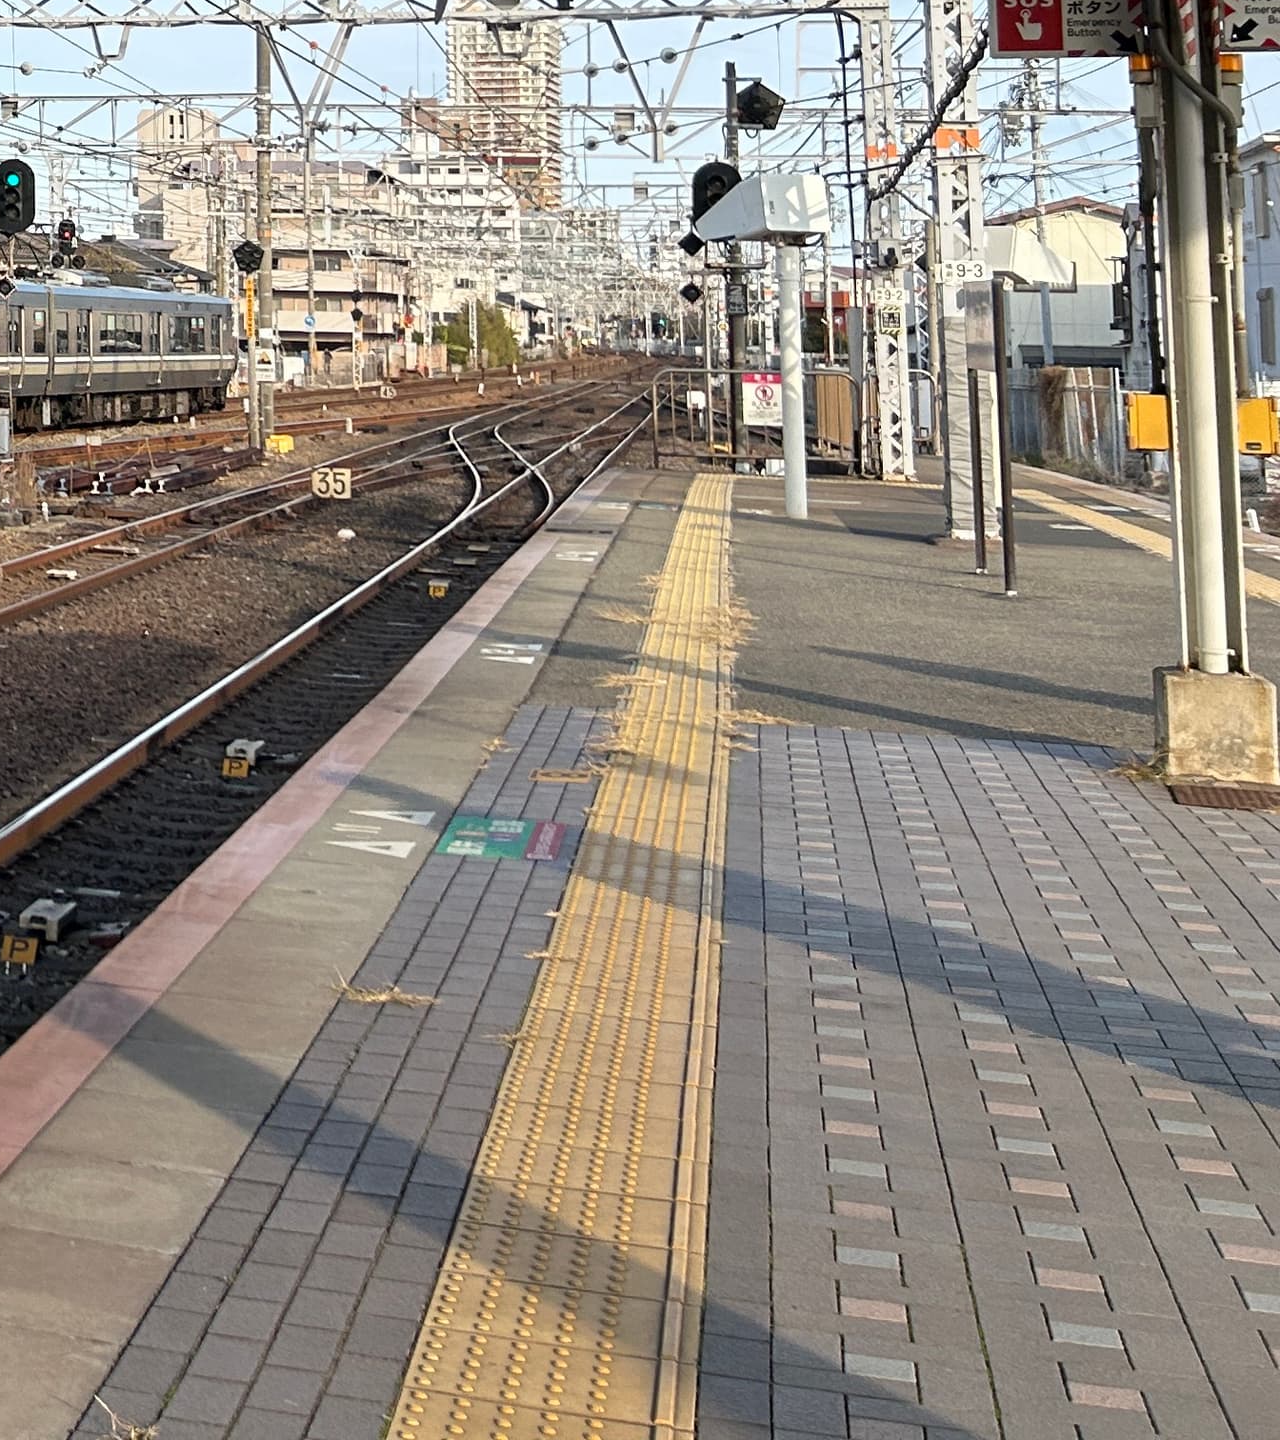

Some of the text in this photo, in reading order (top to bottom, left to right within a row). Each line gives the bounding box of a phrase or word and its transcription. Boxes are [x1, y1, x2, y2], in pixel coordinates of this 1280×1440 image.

[1067, 0, 1121, 16] ボタン
[1066, 17, 1122, 30] Emergency
[1067, 27, 1102, 38] Button
[956, 263, 984, 278] 9-3
[884, 289, 903, 301] 9-2
[317, 471, 346, 496] 35
[228, 760, 244, 774] P
[11, 939, 30, 959] P
